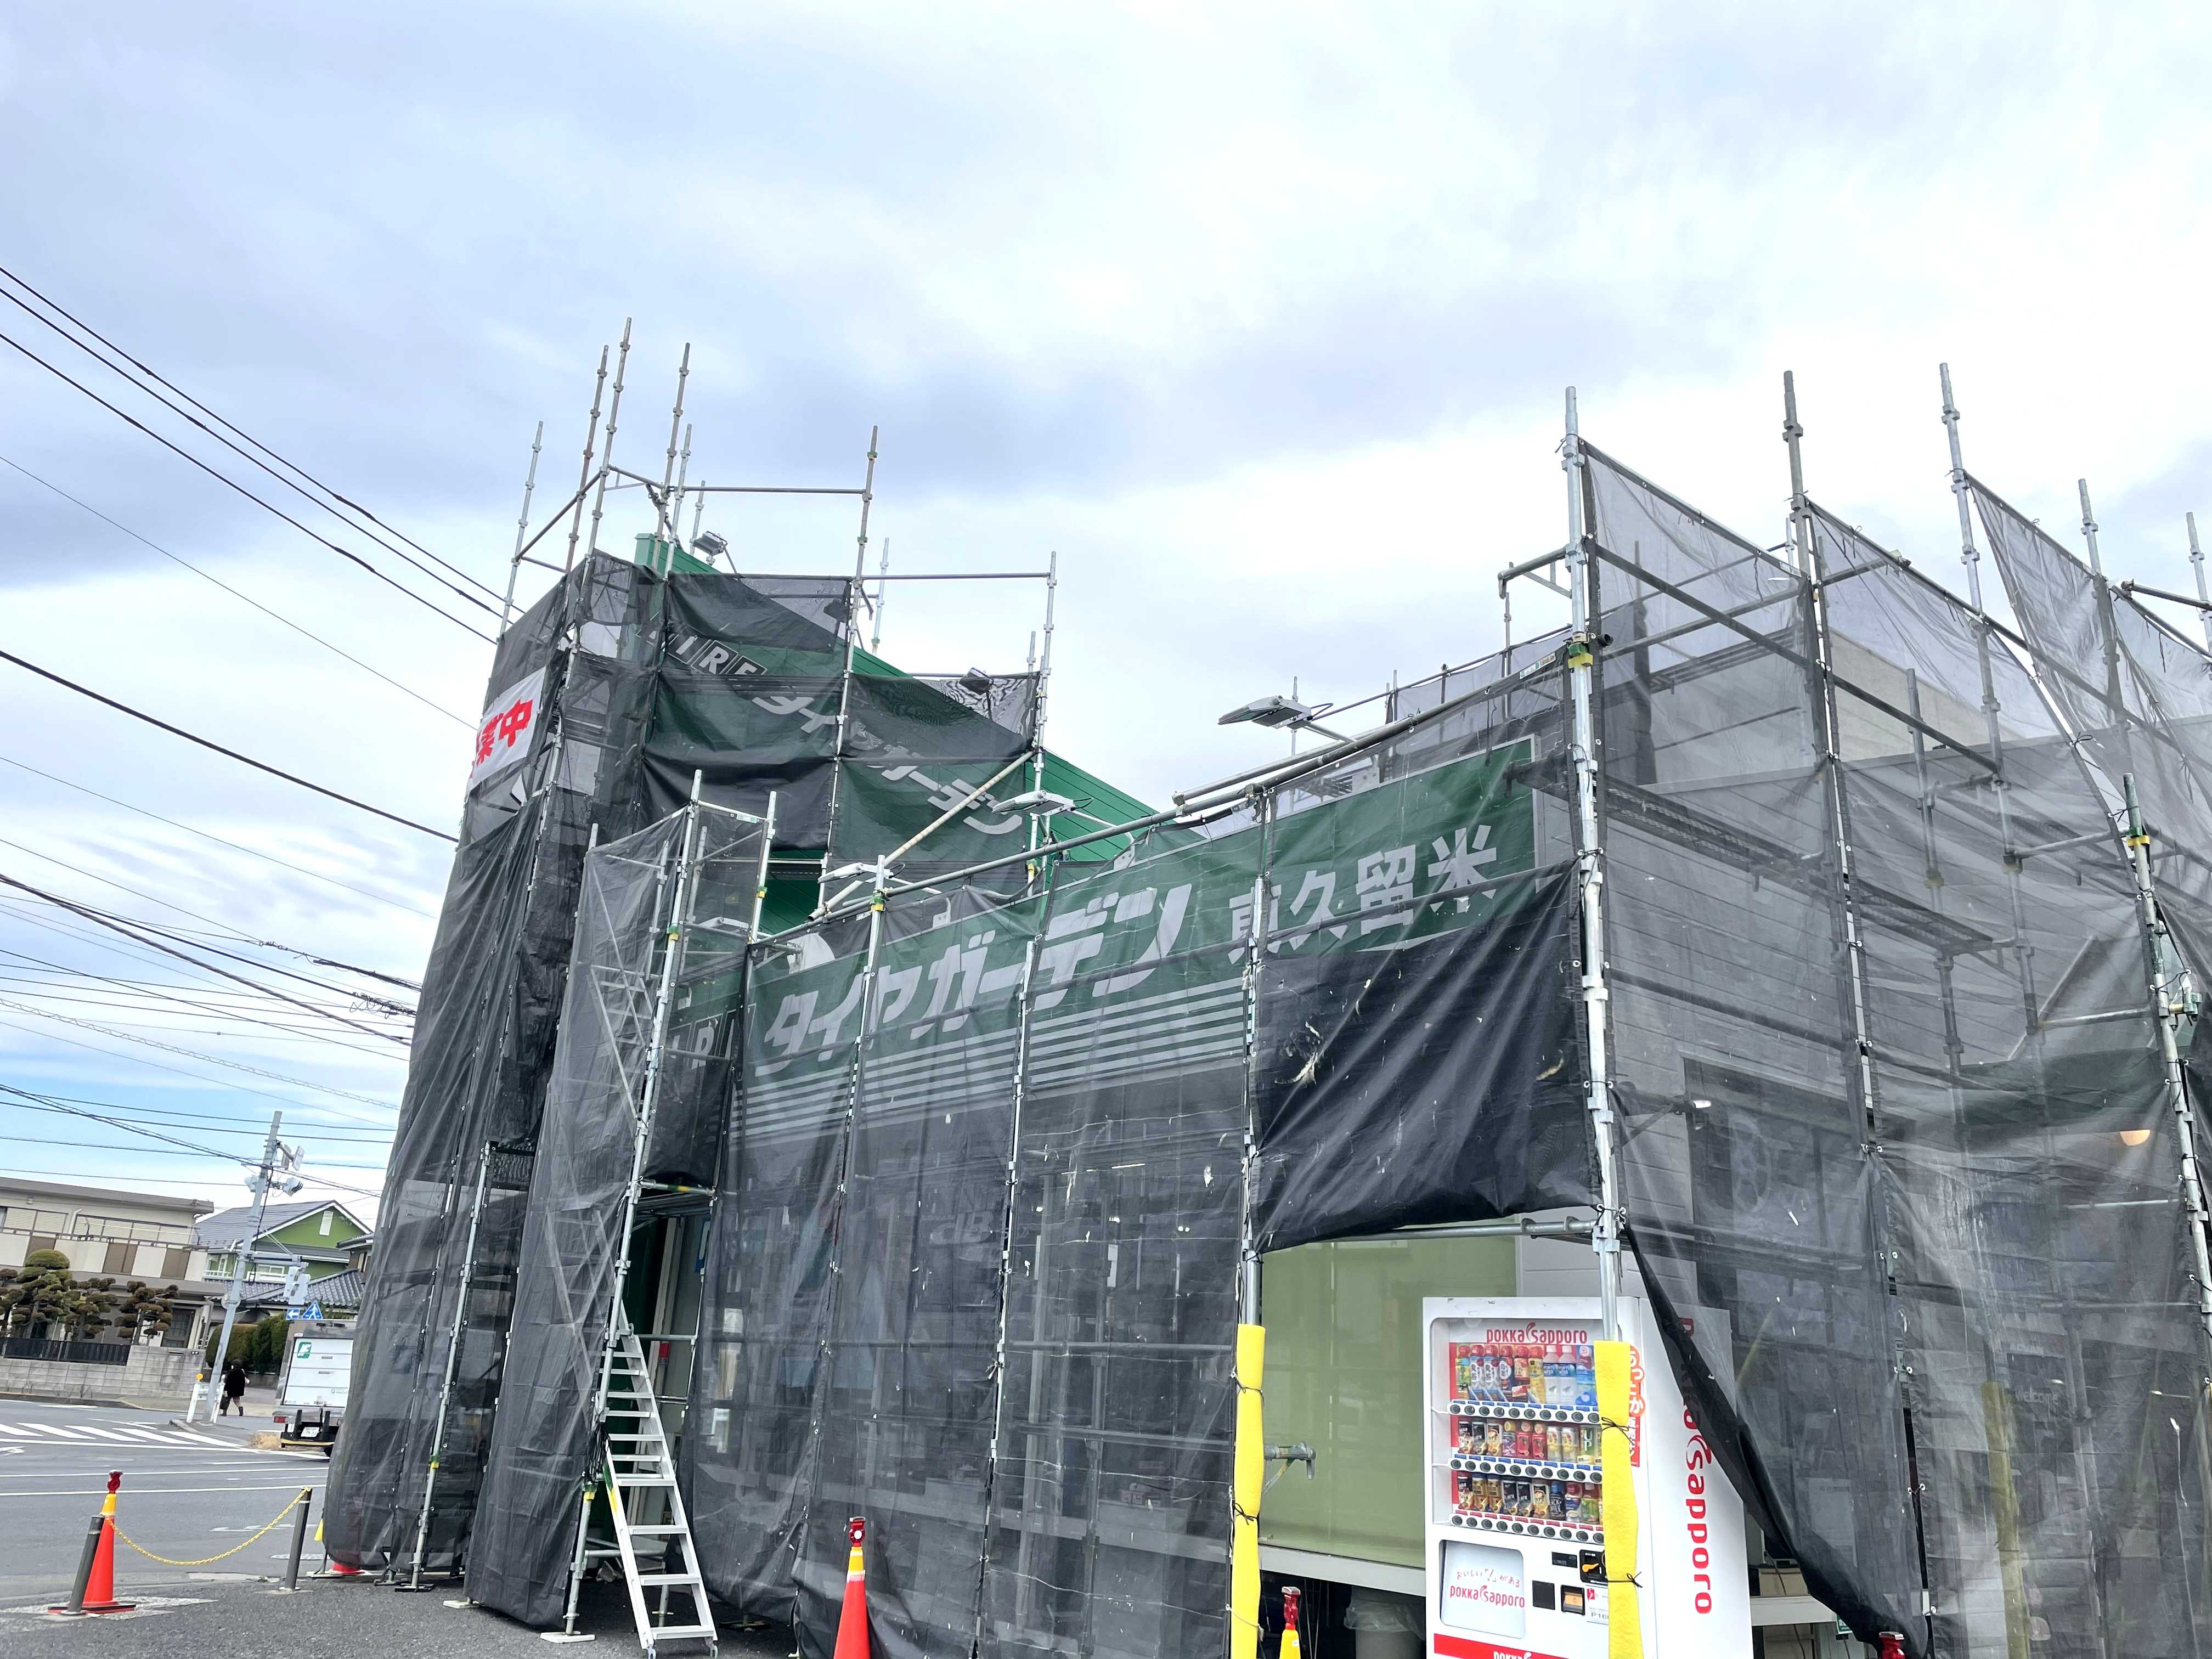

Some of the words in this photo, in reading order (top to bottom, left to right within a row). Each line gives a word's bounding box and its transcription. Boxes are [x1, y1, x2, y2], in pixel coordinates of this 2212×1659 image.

[470, 698, 533, 778] 業中
[755, 883, 1192, 1077] タイヤガーデン
